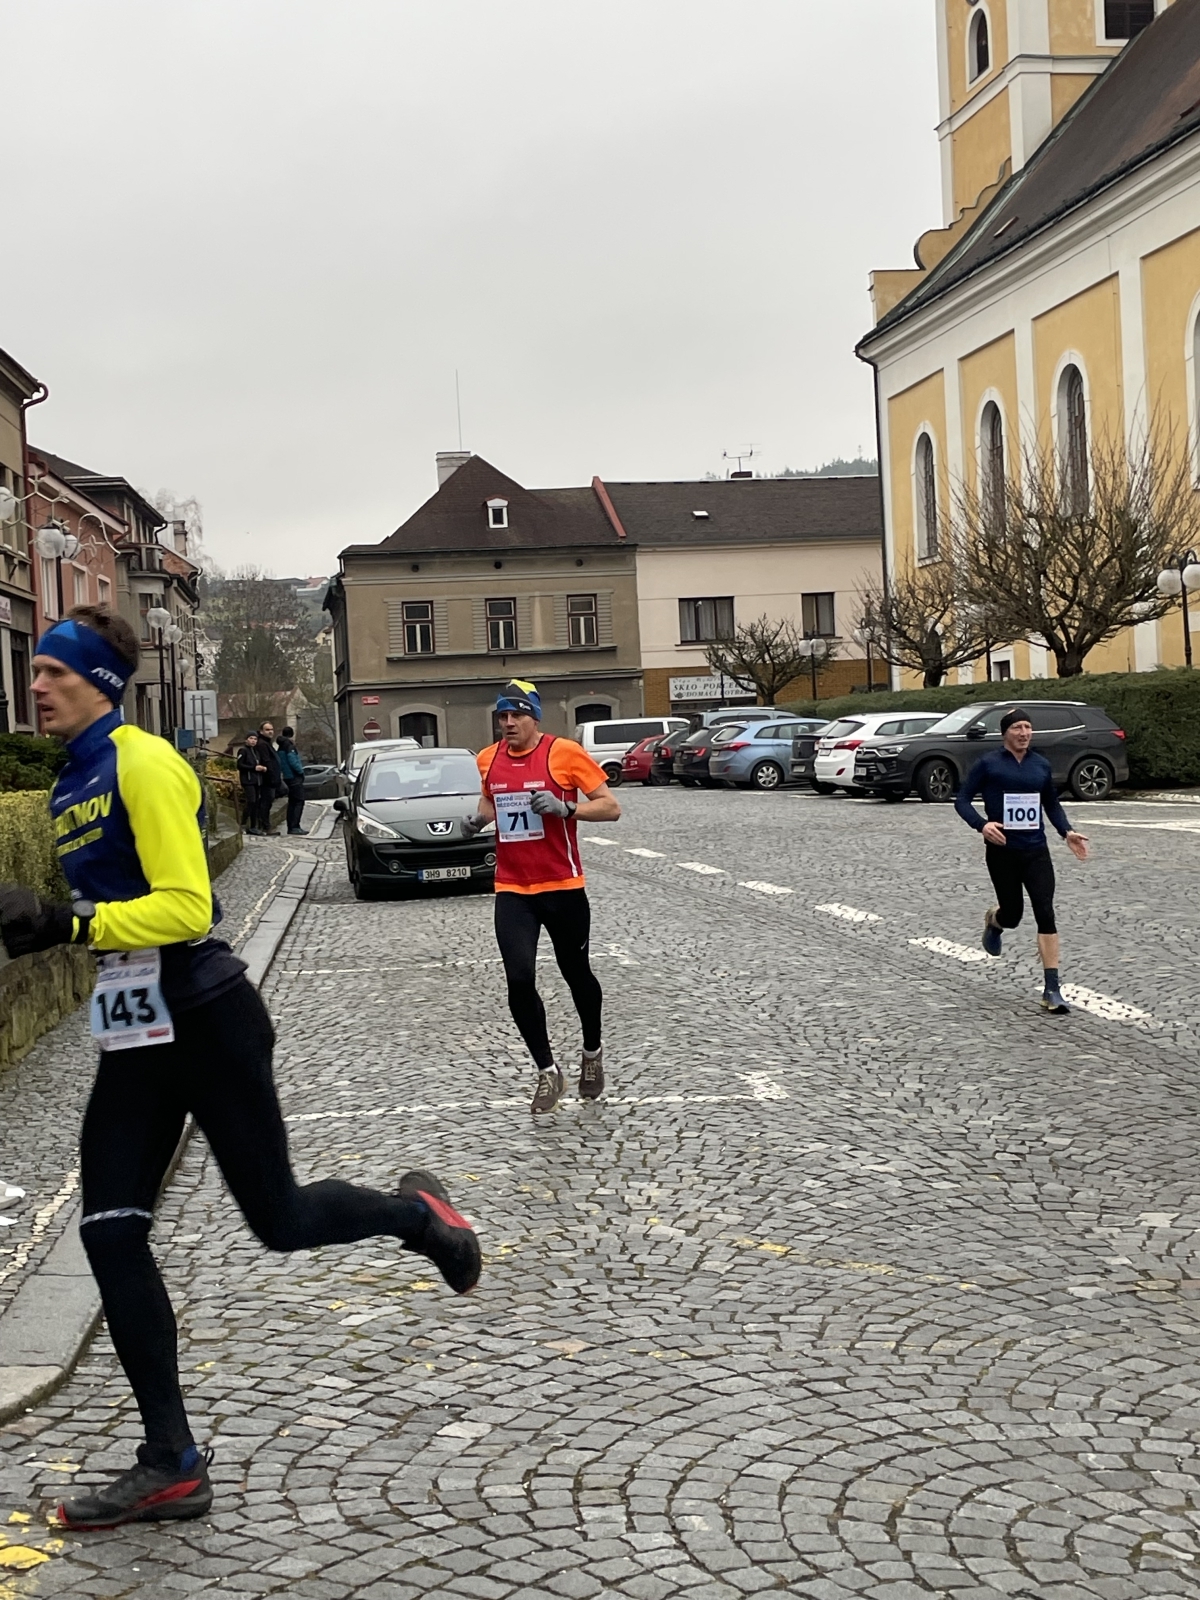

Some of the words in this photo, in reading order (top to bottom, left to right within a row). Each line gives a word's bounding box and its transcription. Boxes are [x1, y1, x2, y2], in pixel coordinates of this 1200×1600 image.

[674, 683, 698, 691] SKLO
[507, 811, 529, 831] 71
[1007, 807, 1037, 822] 100
[424, 870, 441, 879] 3H9
[446, 867, 467, 877] 8210
[96, 987, 156, 1030] 143
